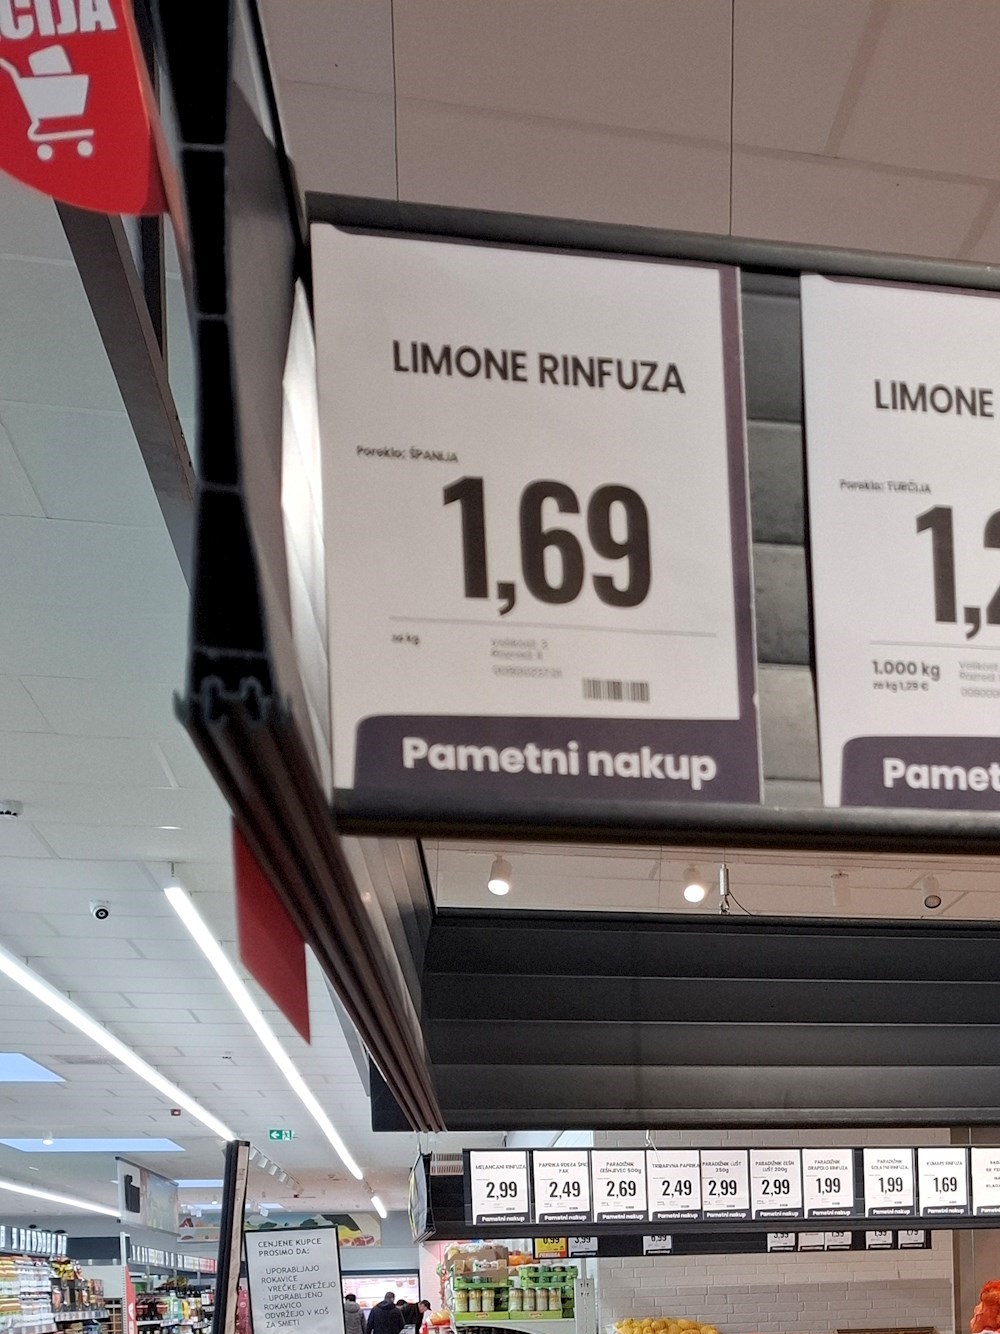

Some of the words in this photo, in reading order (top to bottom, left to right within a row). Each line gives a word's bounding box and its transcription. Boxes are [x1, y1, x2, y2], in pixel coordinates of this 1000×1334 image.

[392, 339, 528, 383] LIMONE
[538, 353, 687, 395] RINFUZA
[874, 378, 994, 420] LIMONE
[442, 475, 653, 617] 1,69
[921, 662, 941, 682] kg
[402, 736, 580, 777] Pametni
[588, 747, 718, 792] nakup
[486, 1181, 518, 1200] 2,99
[549, 1181, 581, 1199] 2,49
[606, 1180, 637, 1199] 2,69
[662, 1179, 692, 1198] 2,49
[708, 1179, 737, 1198] 2,99
[761, 1179, 790, 1197] 2,99
[816, 1178, 841, 1195] 1,99
[878, 1177, 903, 1194] 1,99
[933, 1176, 958, 1194] 1,69
[258, 1239, 293, 1248] CENJENE
[296, 1238, 322, 1246] KUPCE
[266, 1265, 320, 1274] UPORABLJAJO
[261, 1275, 298, 1284] ROKAVICE
[268, 1283, 296, 1292] VREČKE
[299, 1281, 336, 1290] ZAVEŽEJO
[268, 1291, 323, 1301] UPORABLJENO
[264, 1302, 302, 1310] ROKAVICO
[264, 1310, 304, 1320] ODVRŽEJO
